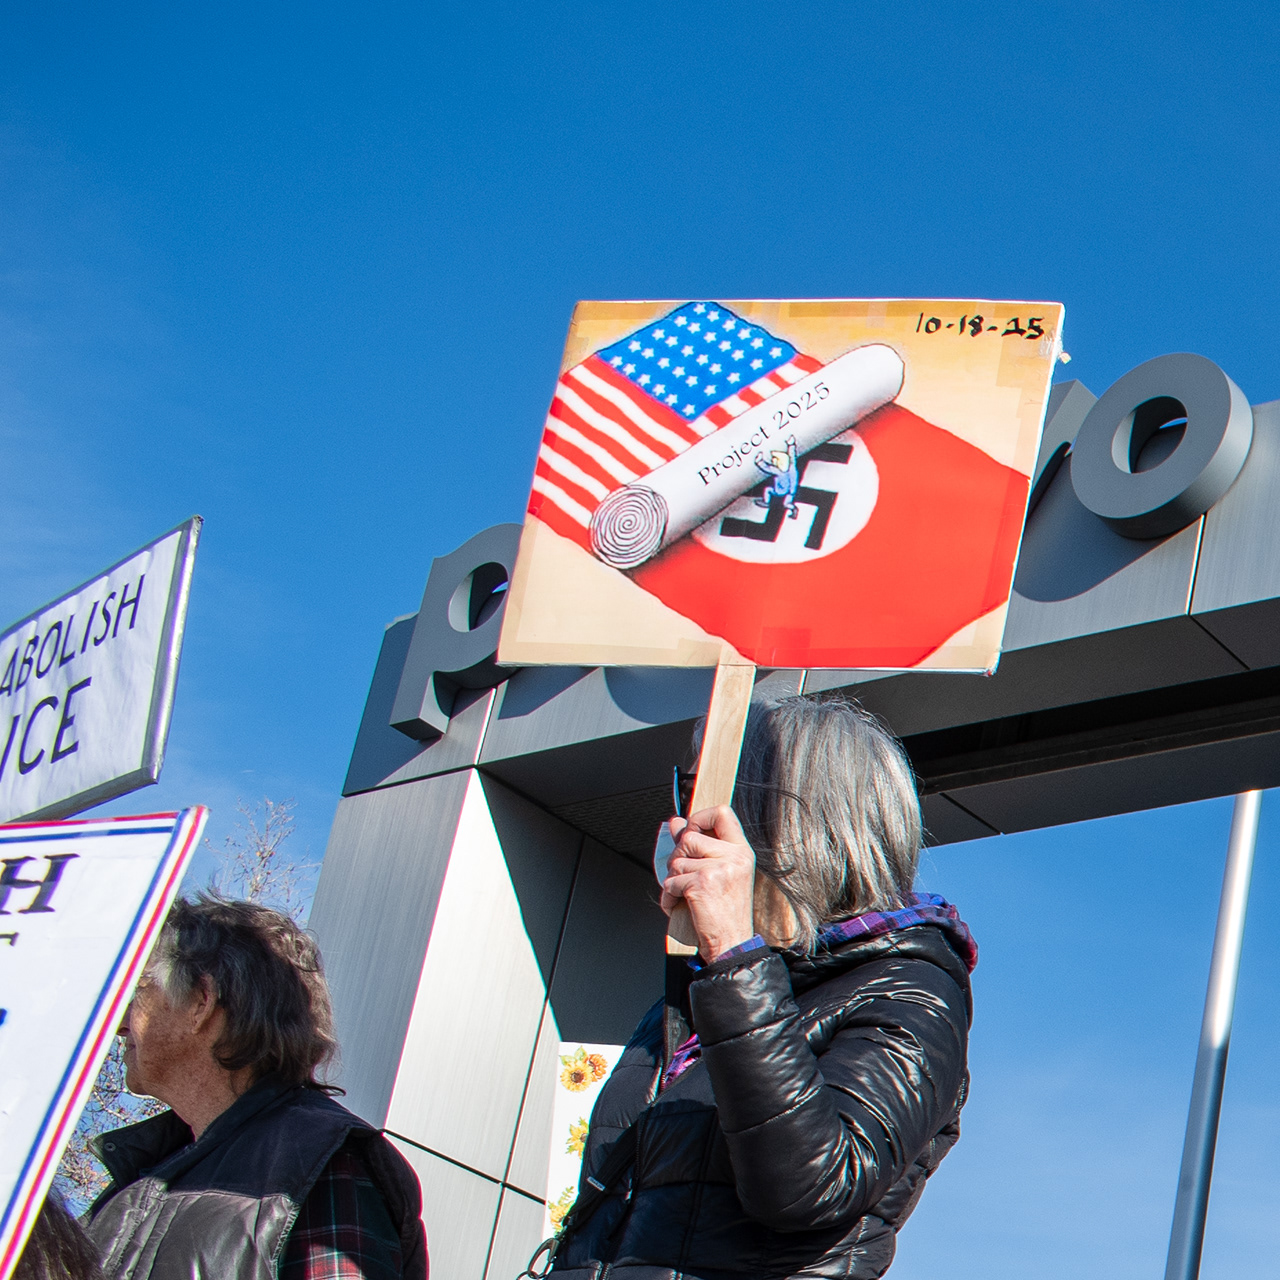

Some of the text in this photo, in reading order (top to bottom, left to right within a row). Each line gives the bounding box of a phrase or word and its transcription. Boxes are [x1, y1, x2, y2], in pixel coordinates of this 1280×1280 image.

[916, 312, 1045, 340] 10-18-25
[697, 381, 830, 486] Project 2025
[0, 574, 146, 697] ABOLISH
[0, 676, 93, 783] ICE
